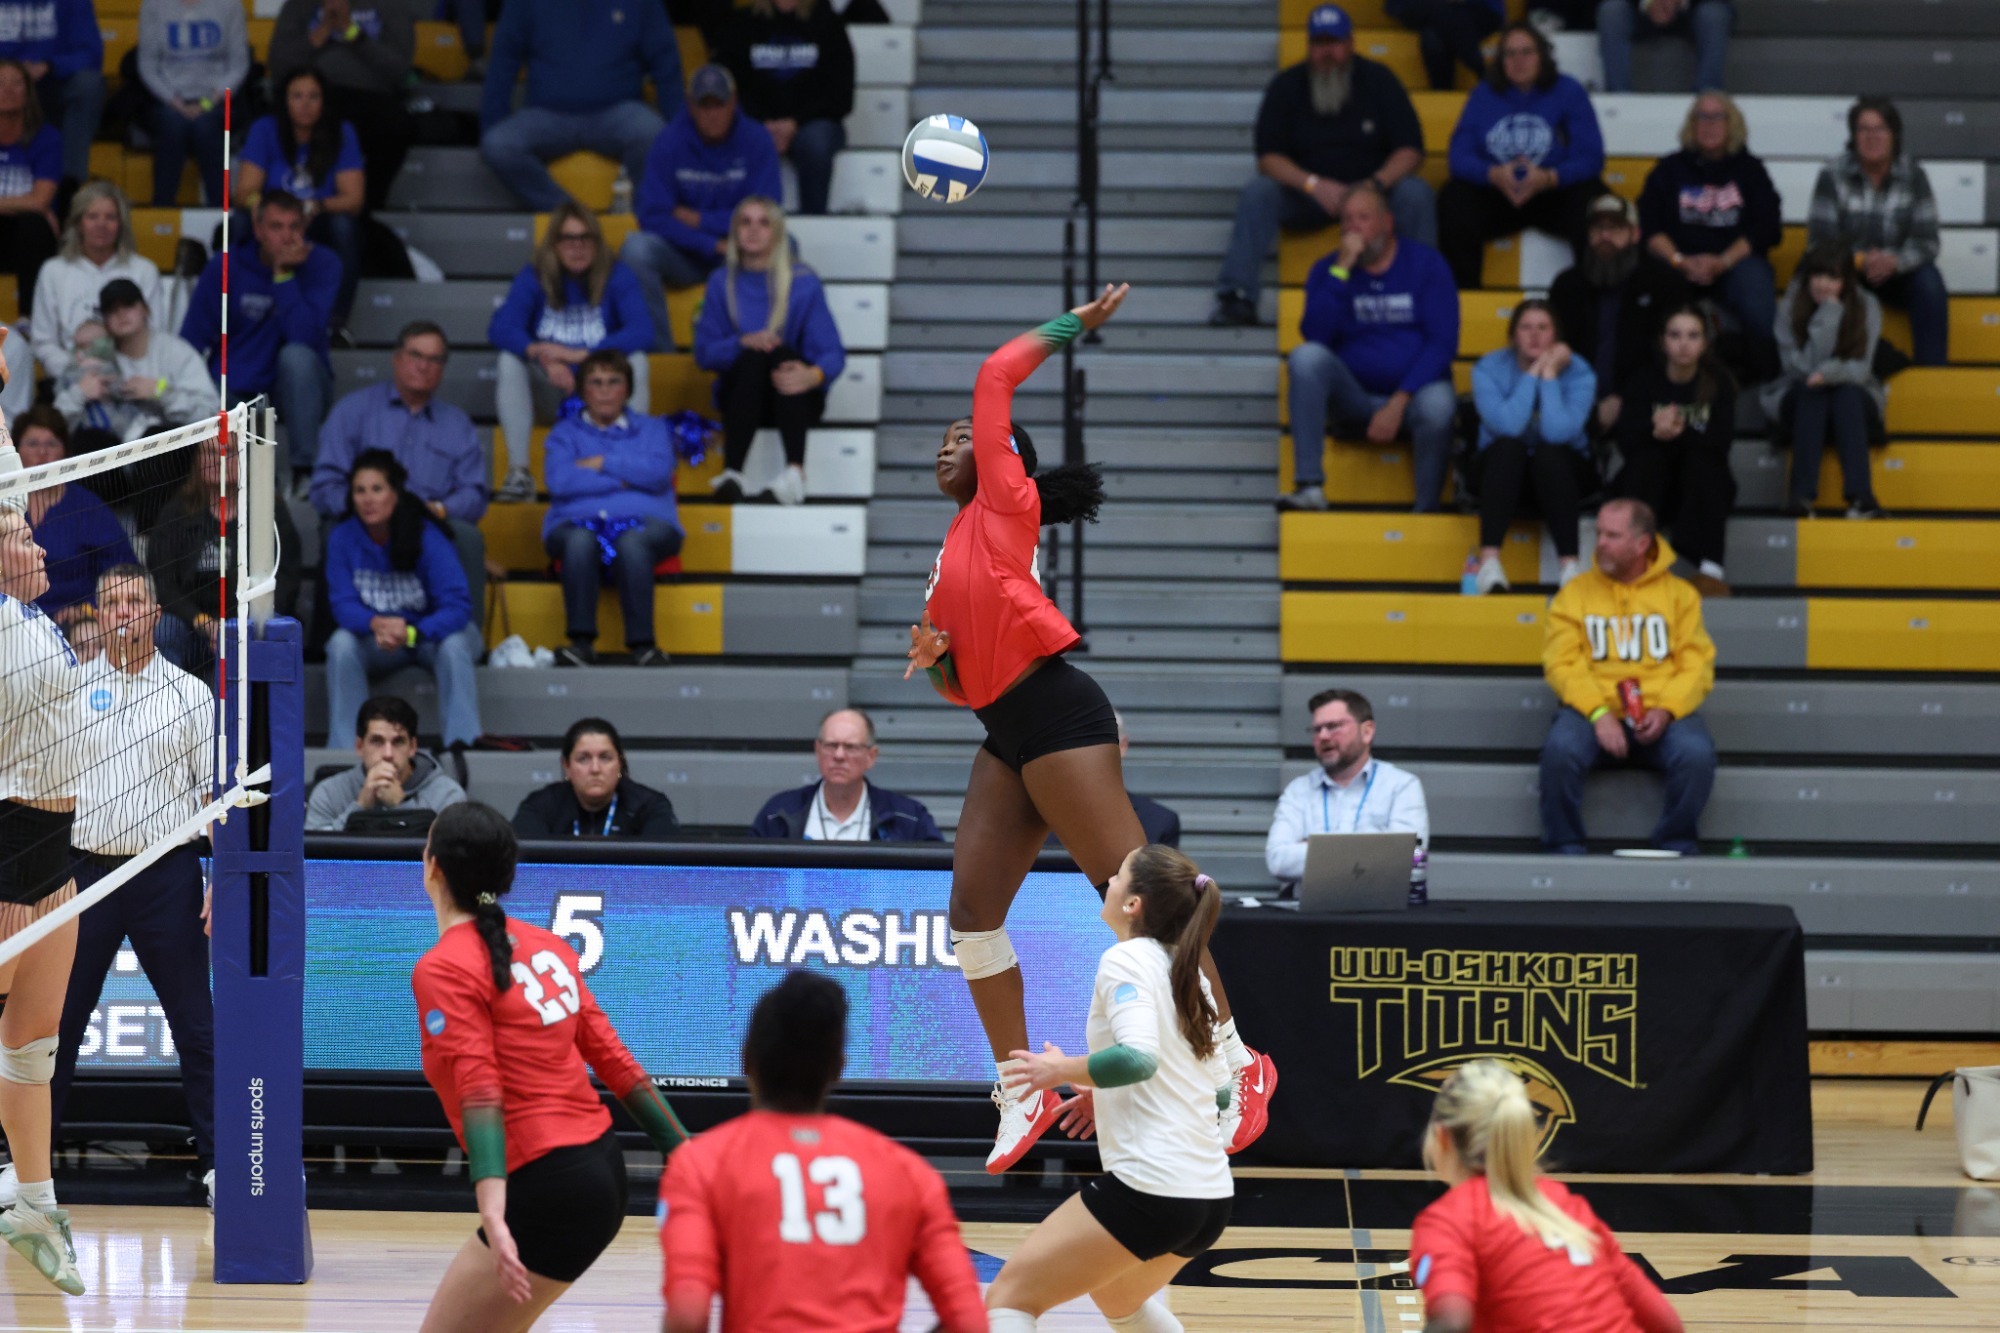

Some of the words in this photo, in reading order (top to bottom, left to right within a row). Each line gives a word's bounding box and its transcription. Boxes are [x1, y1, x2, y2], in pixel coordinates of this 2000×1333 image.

[1584, 613, 1669, 661] UWO
[552, 895, 603, 972] 5
[510, 950, 580, 1026] 23
[1331, 947, 1637, 988] UW-OSHKOSH
[1330, 982, 1637, 1089] TITANS
[248, 1077, 266, 1130] sports
[651, 1077, 729, 1087] AKTRONICS
[771, 1152, 867, 1246] 13
